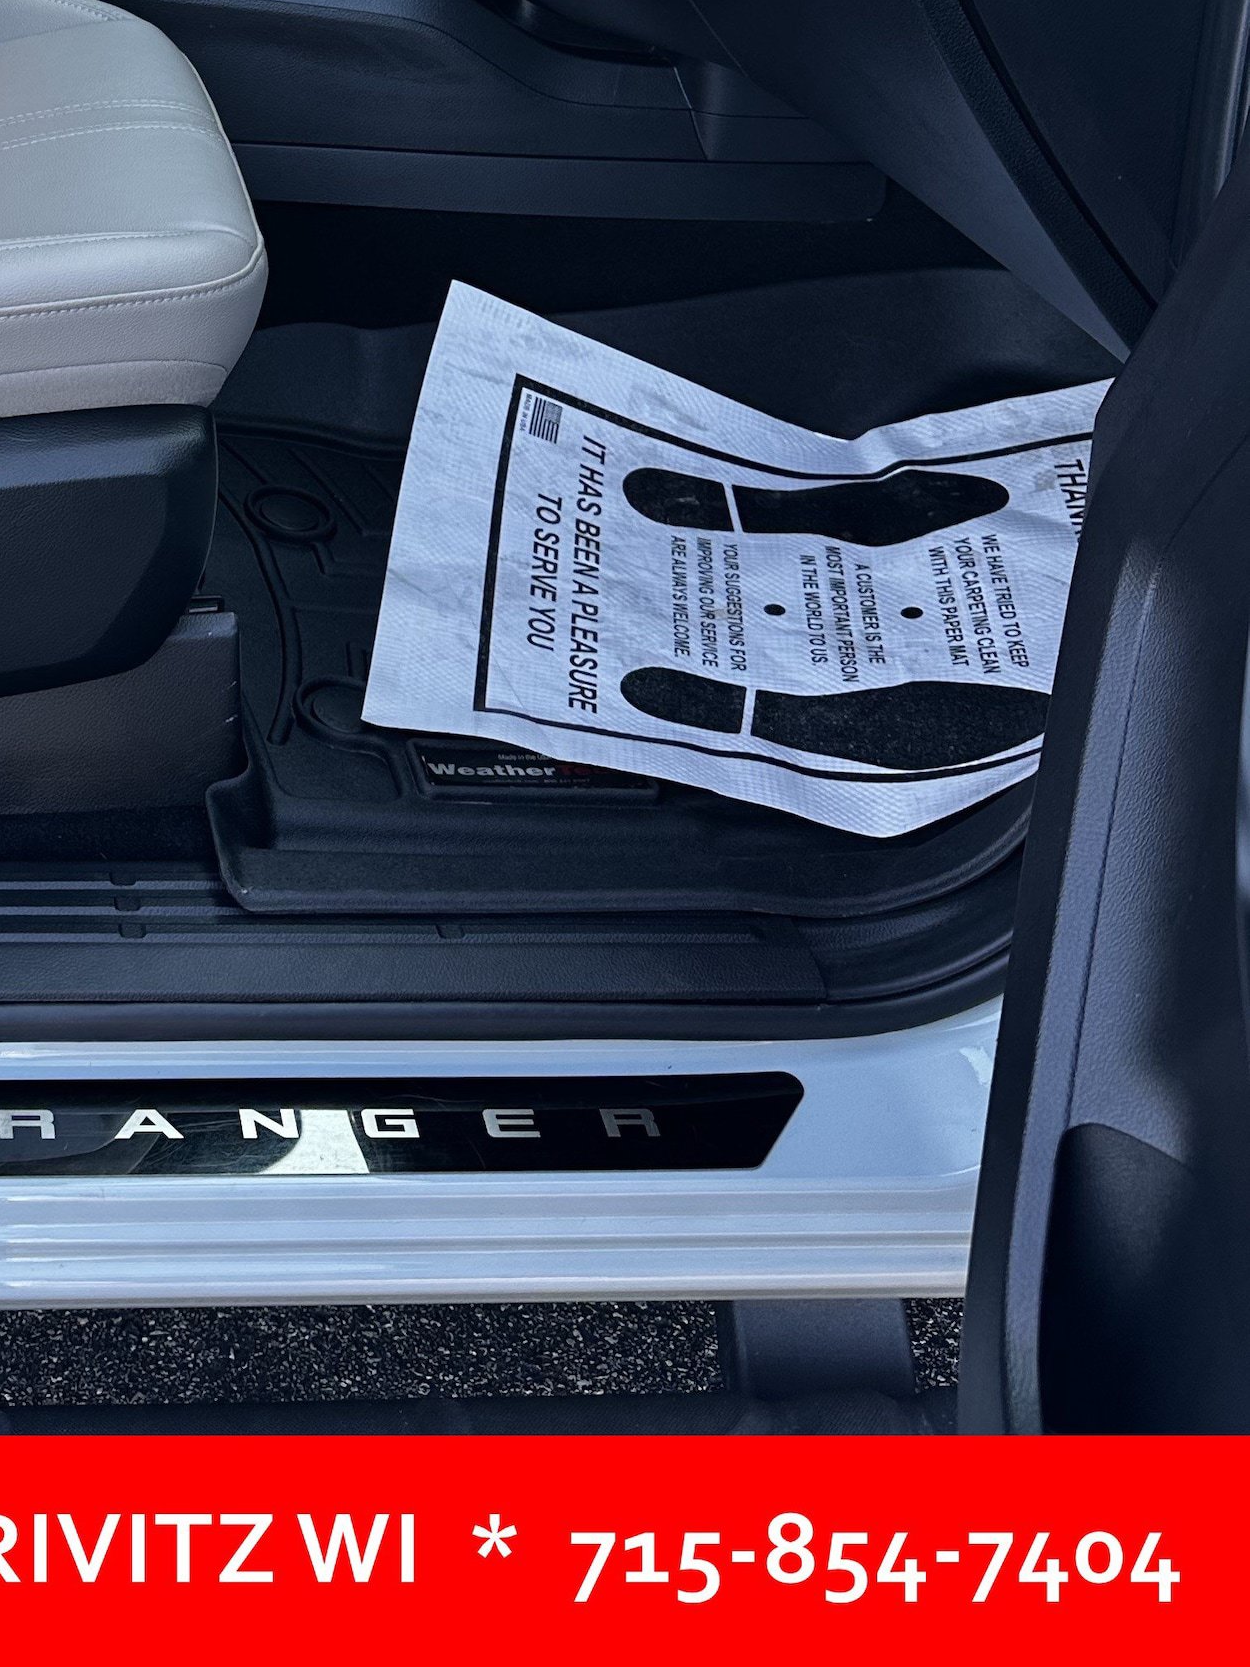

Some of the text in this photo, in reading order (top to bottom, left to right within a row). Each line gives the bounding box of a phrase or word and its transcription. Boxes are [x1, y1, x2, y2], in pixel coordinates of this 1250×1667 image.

[526, 492, 562, 652] TO SERVE YOU
[568, 435, 606, 714] IT HAS BEEN A PLEASURE
[671, 536, 690, 657] ARE ALWAYS WELCOME.
[697, 537, 718, 667] IMPROVING OUR SERVICE
[724, 544, 746, 670] YOUR SUGGESTIONS FOR
[800, 555, 816, 565] IN
[802, 568, 819, 588] THE
[805, 592, 824, 630] WORLD
[825, 546, 859, 682] MOST IMPORTANT PERSON
[856, 574, 879, 629] CUSTOMER
[928, 546, 969, 666] WITH THIS PAPER MAT
[954, 537, 1001, 674] YOUR CARPETING CLEAN
[982, 534, 1029, 667] WE HAVE TRIED TO KEEP
[809, 633, 826, 646] TO
[865, 632, 881, 642] IS
[867, 645, 885, 664] THE
